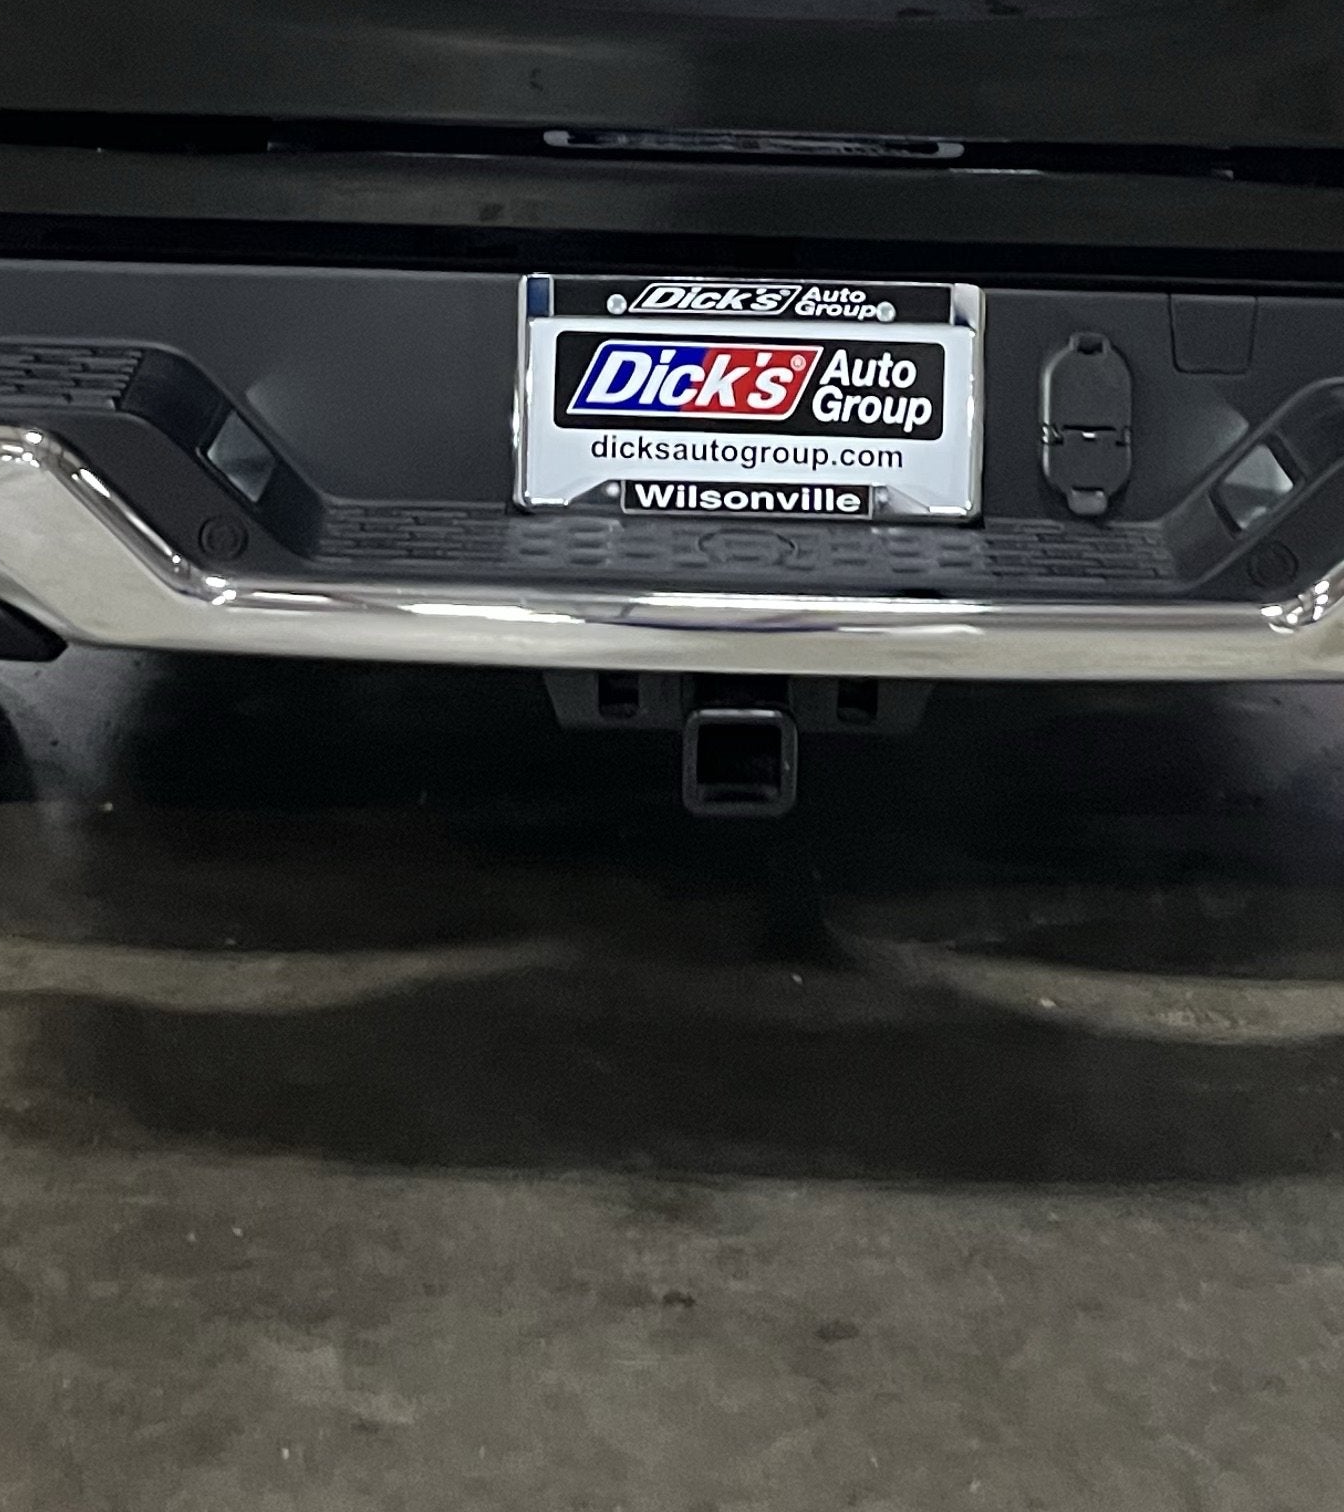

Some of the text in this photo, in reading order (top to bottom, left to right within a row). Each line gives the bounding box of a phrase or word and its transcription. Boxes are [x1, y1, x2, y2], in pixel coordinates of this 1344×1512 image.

[642, 286, 784, 312] Dick's
[794, 299, 877, 321] Group
[805, 287, 867, 304] Auto
[586, 348, 794, 409] Dick's
[820, 350, 917, 389] Auto
[812, 387, 933, 432] Group
[590, 434, 904, 469] dicksautogroup.com
[634, 484, 862, 513] Wilsonville
